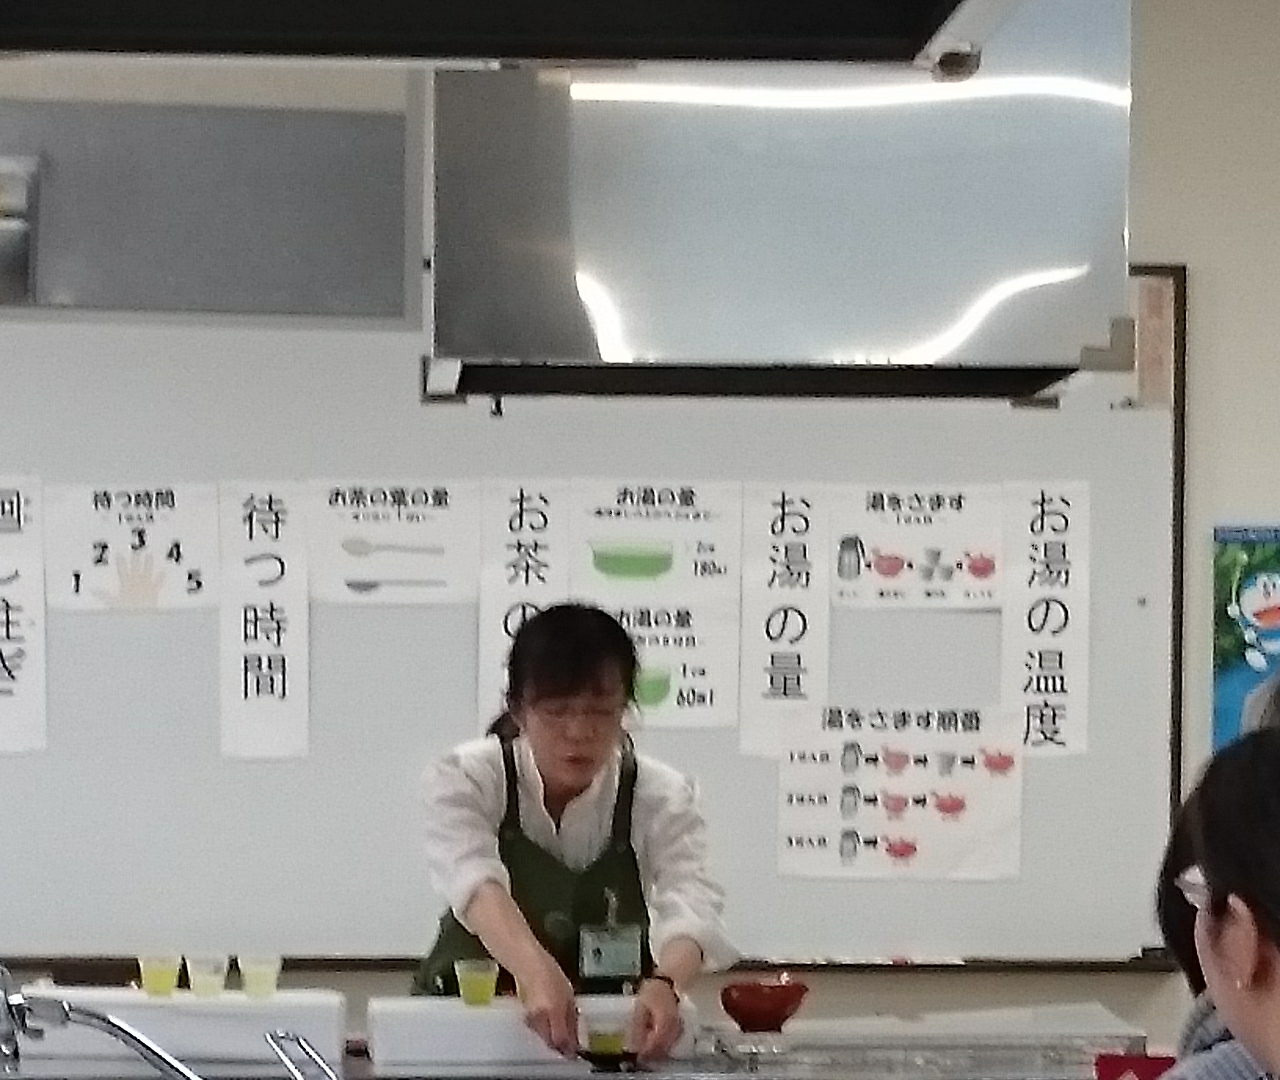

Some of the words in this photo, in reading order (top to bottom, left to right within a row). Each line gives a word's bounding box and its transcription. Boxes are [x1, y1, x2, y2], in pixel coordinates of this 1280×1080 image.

[94, 490, 176, 511] 待つ時間
[616, 485, 697, 506] お湯の量
[866, 491, 965, 512] 湯をさます
[130, 527, 148, 551] 3
[93, 541, 110, 566] 2
[166, 540, 183, 565] 4
[72, 570, 82, 594] 1
[187, 569, 203, 594] 5
[242, 493, 288, 700] 待つ時間
[762, 490, 811, 700] お湯の量
[1023, 489, 1072, 747] お湯の温度
[821, 706, 980, 732] 湯をさます順番
